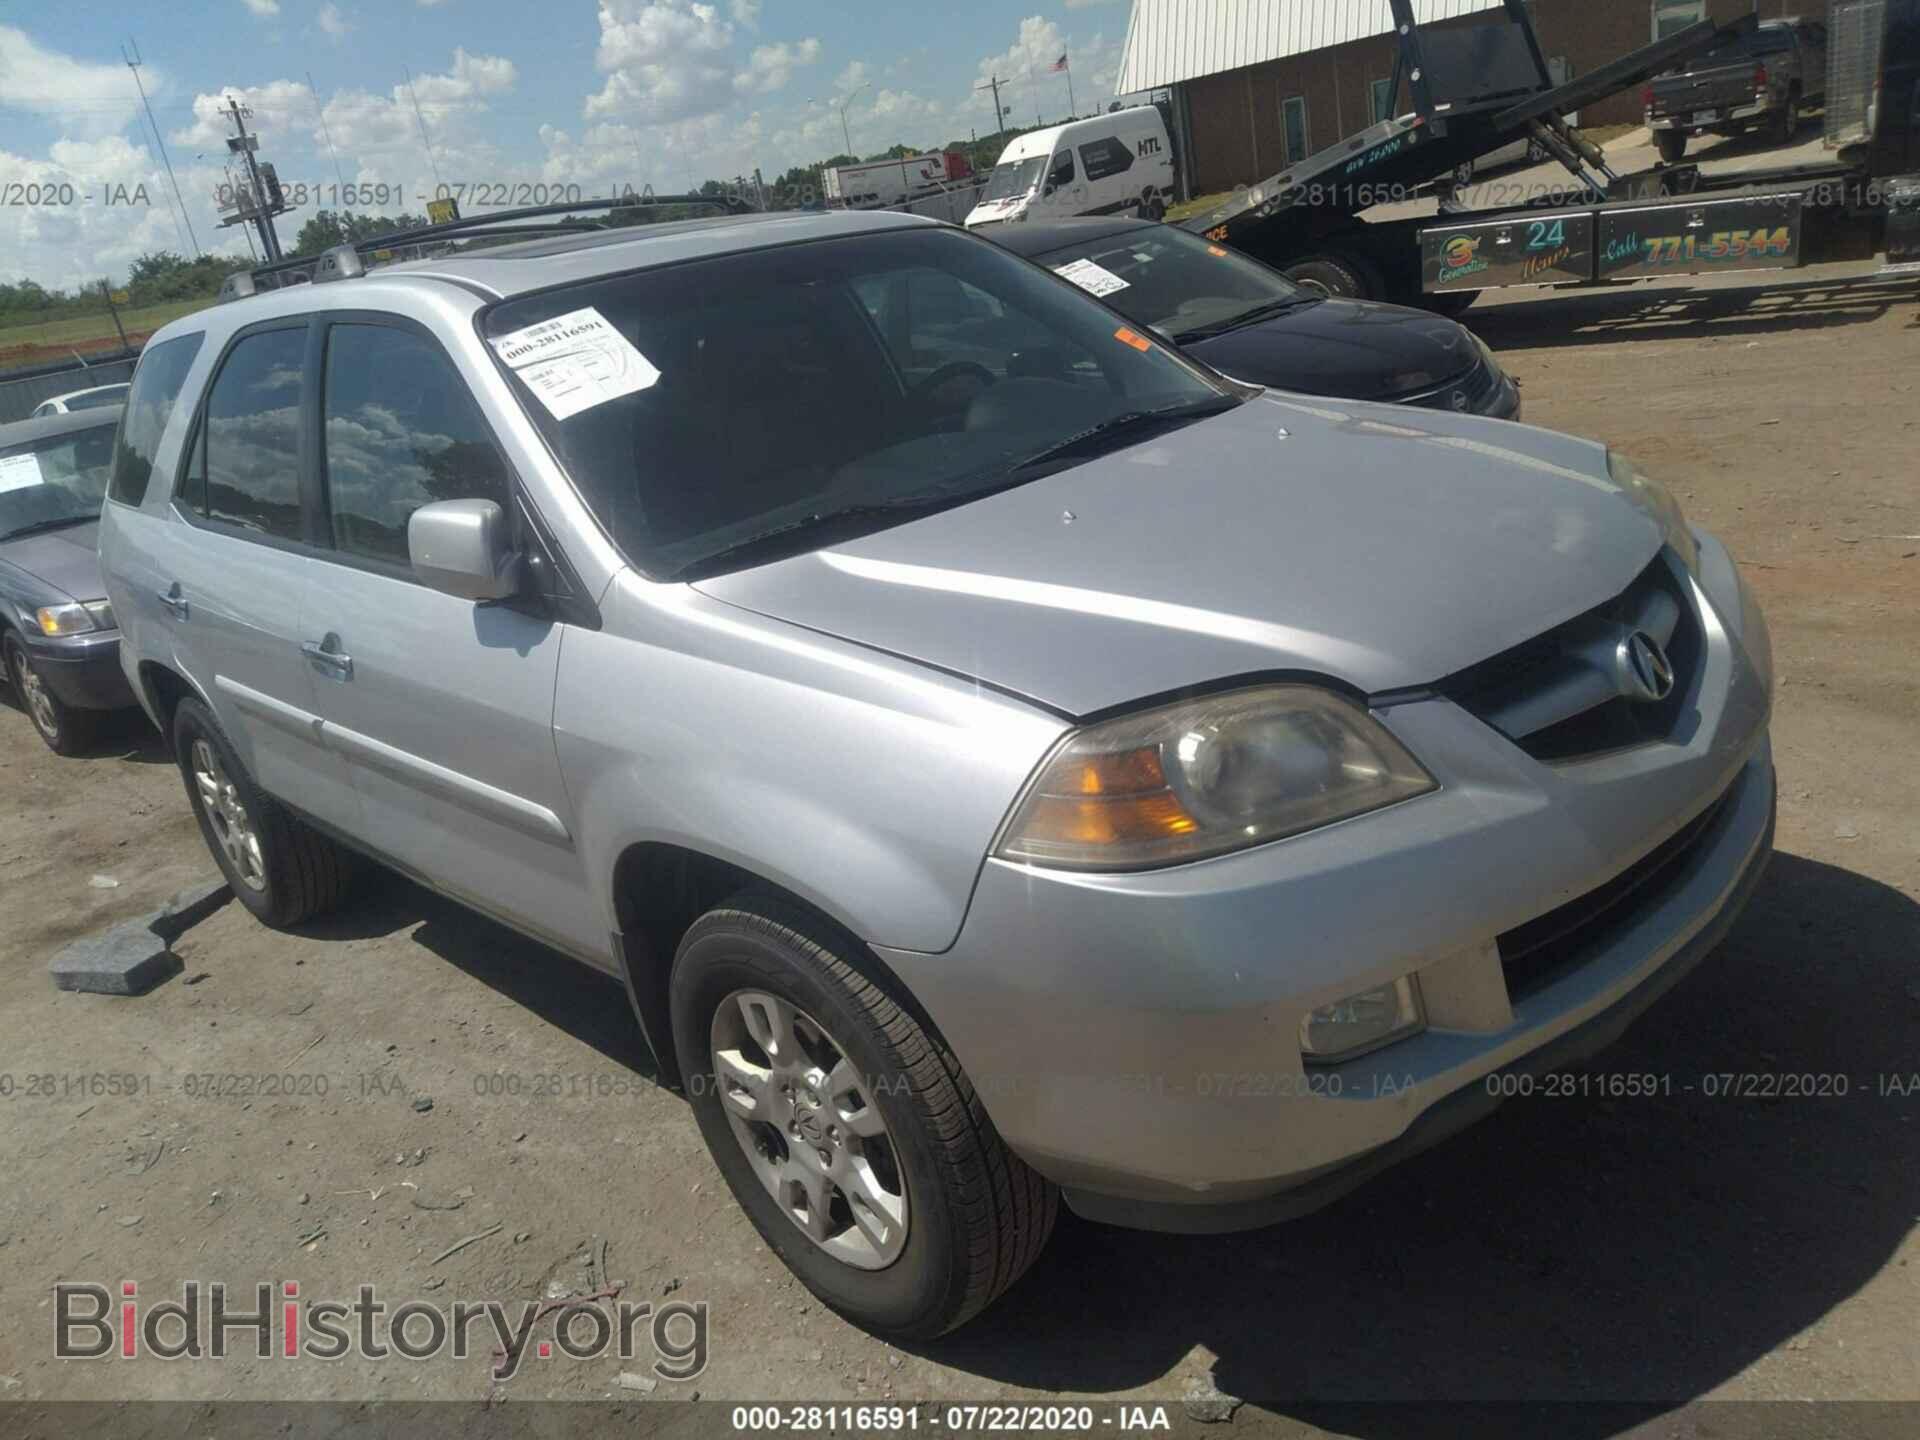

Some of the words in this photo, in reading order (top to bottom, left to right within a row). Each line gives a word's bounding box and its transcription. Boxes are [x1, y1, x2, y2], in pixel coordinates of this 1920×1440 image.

[1137, 137, 1162, 157] HTL
[1529, 220, 1565, 248] 24
[1643, 226, 1790, 263] 771-5544
[505, 321, 603, 360] 000-28116591
